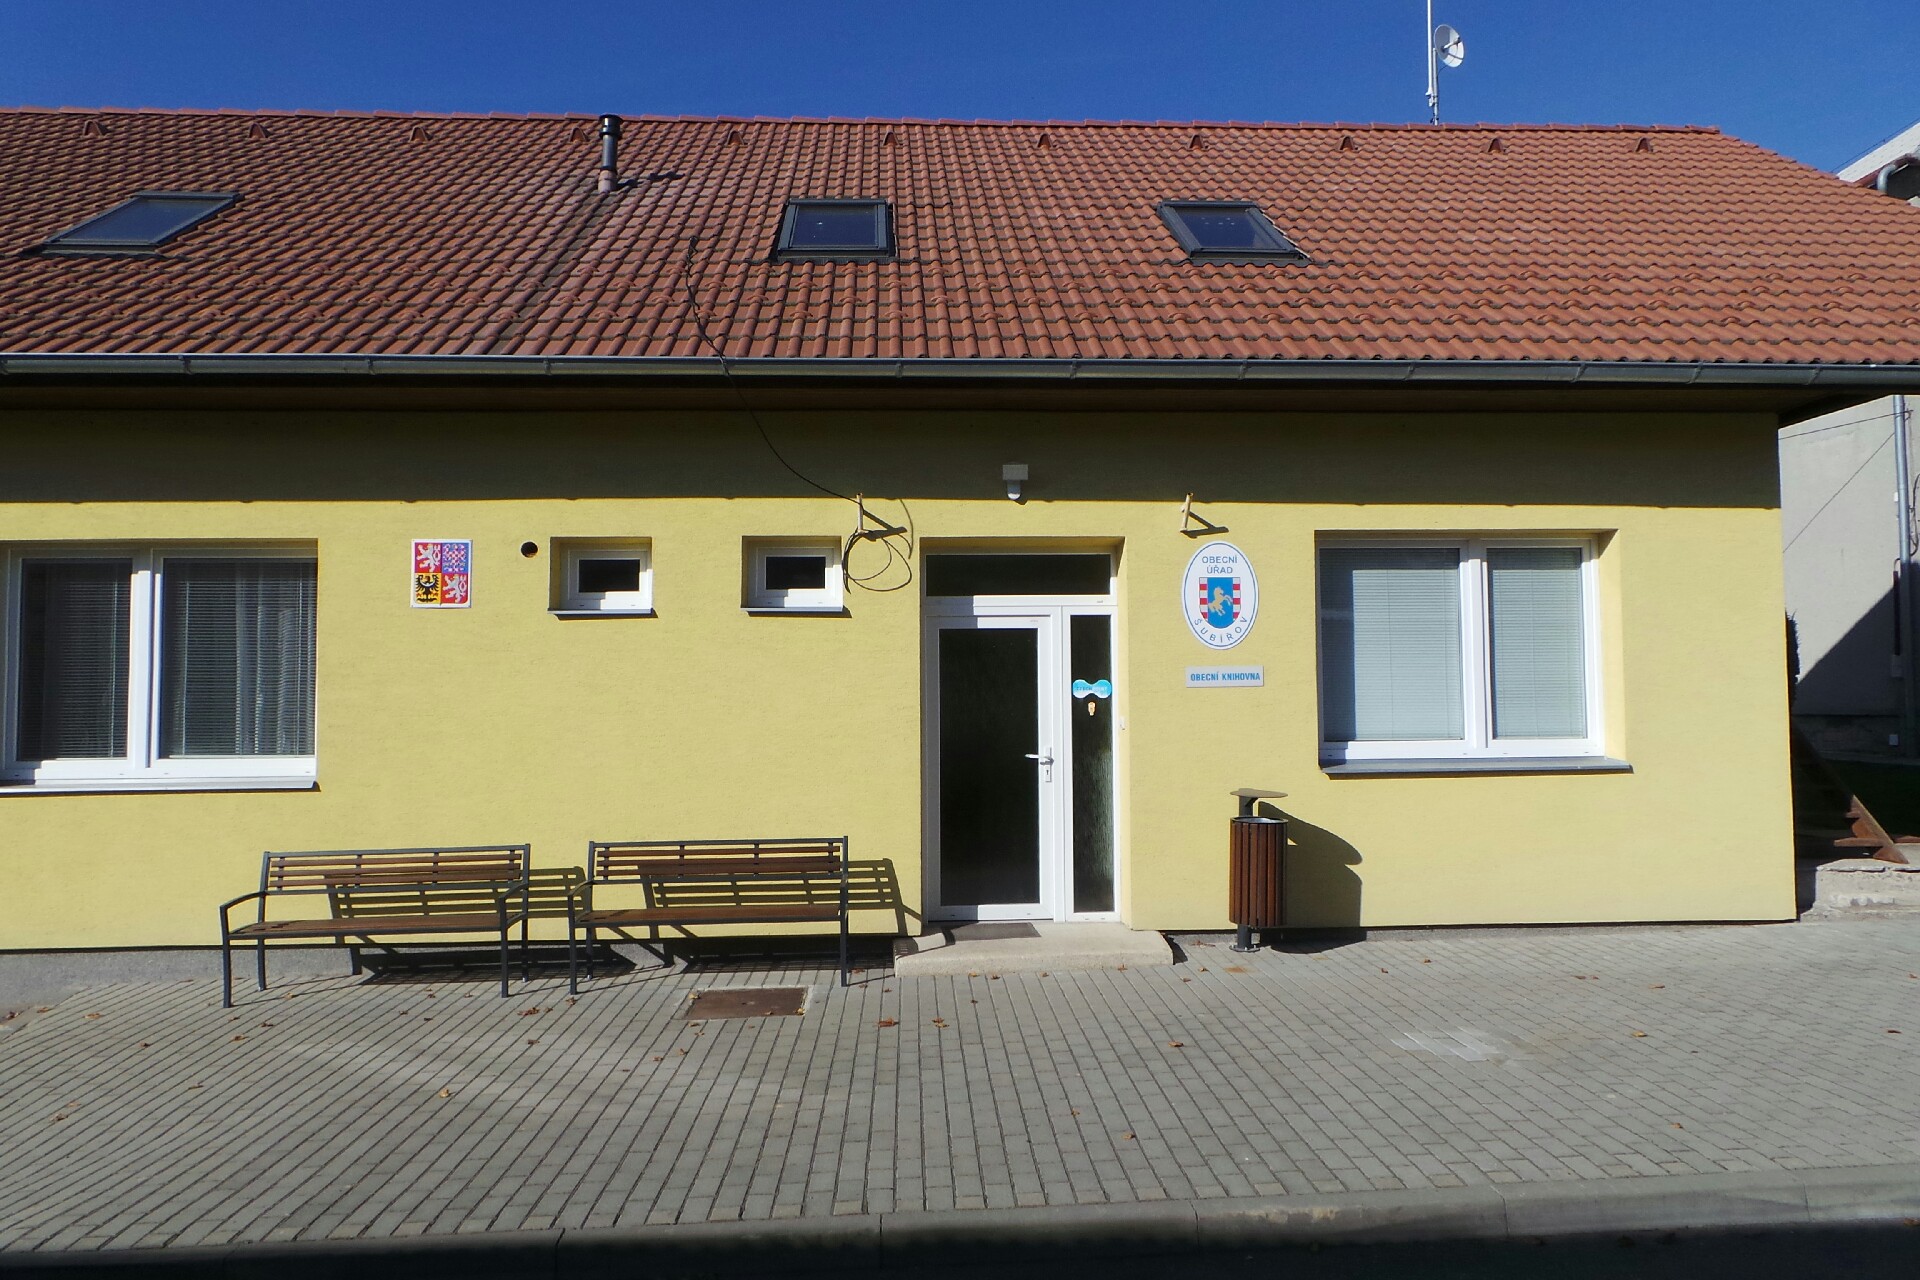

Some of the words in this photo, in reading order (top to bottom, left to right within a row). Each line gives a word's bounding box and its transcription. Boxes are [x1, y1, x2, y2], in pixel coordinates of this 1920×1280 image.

[1202, 555, 1238, 564] OBECNÍ
[1206, 565, 1233, 574] ÚŘAD
[1190, 671, 1219, 681] OBECNÍ
[1222, 672, 1261, 681] KNIHOVNA
